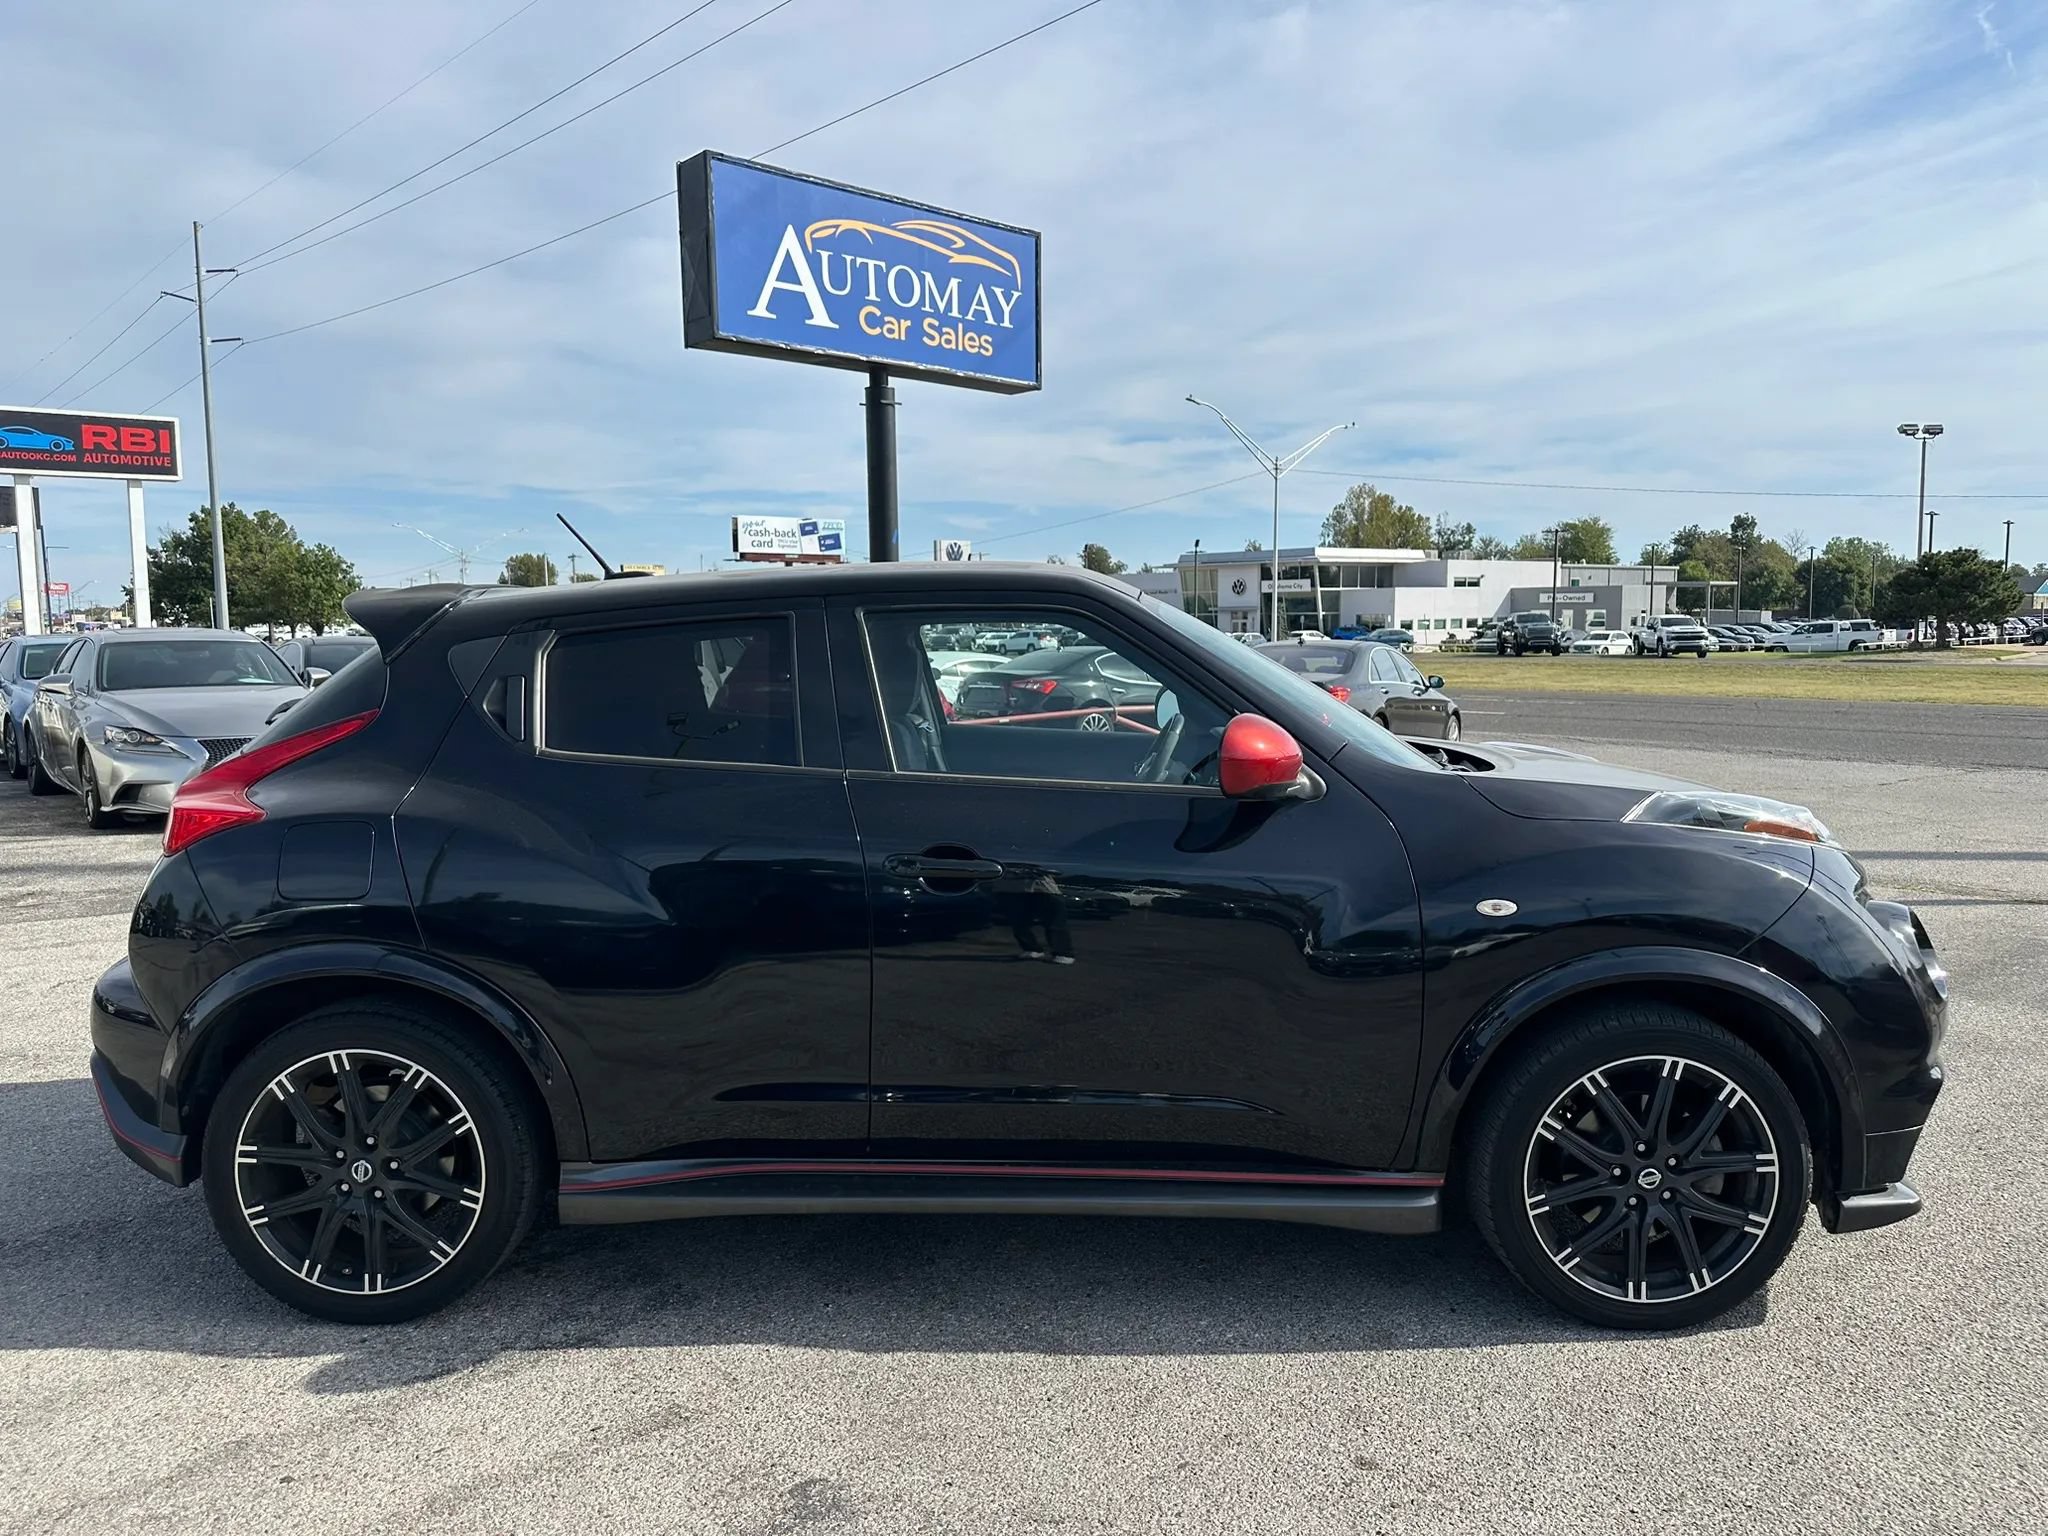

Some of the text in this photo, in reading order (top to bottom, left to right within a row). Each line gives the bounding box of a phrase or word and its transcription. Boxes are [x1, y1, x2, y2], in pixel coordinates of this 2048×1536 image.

[747, 224, 1022, 329] AUTOMAY
[859, 305, 993, 357] Car Sales
[82, 424, 171, 453] RBI
[0, 451, 76, 462] AUTOOKC.COM
[84, 453, 171, 466] AUTOMOTIVE
[748, 528, 797, 538] cash-back
[751, 538, 773, 548] card
